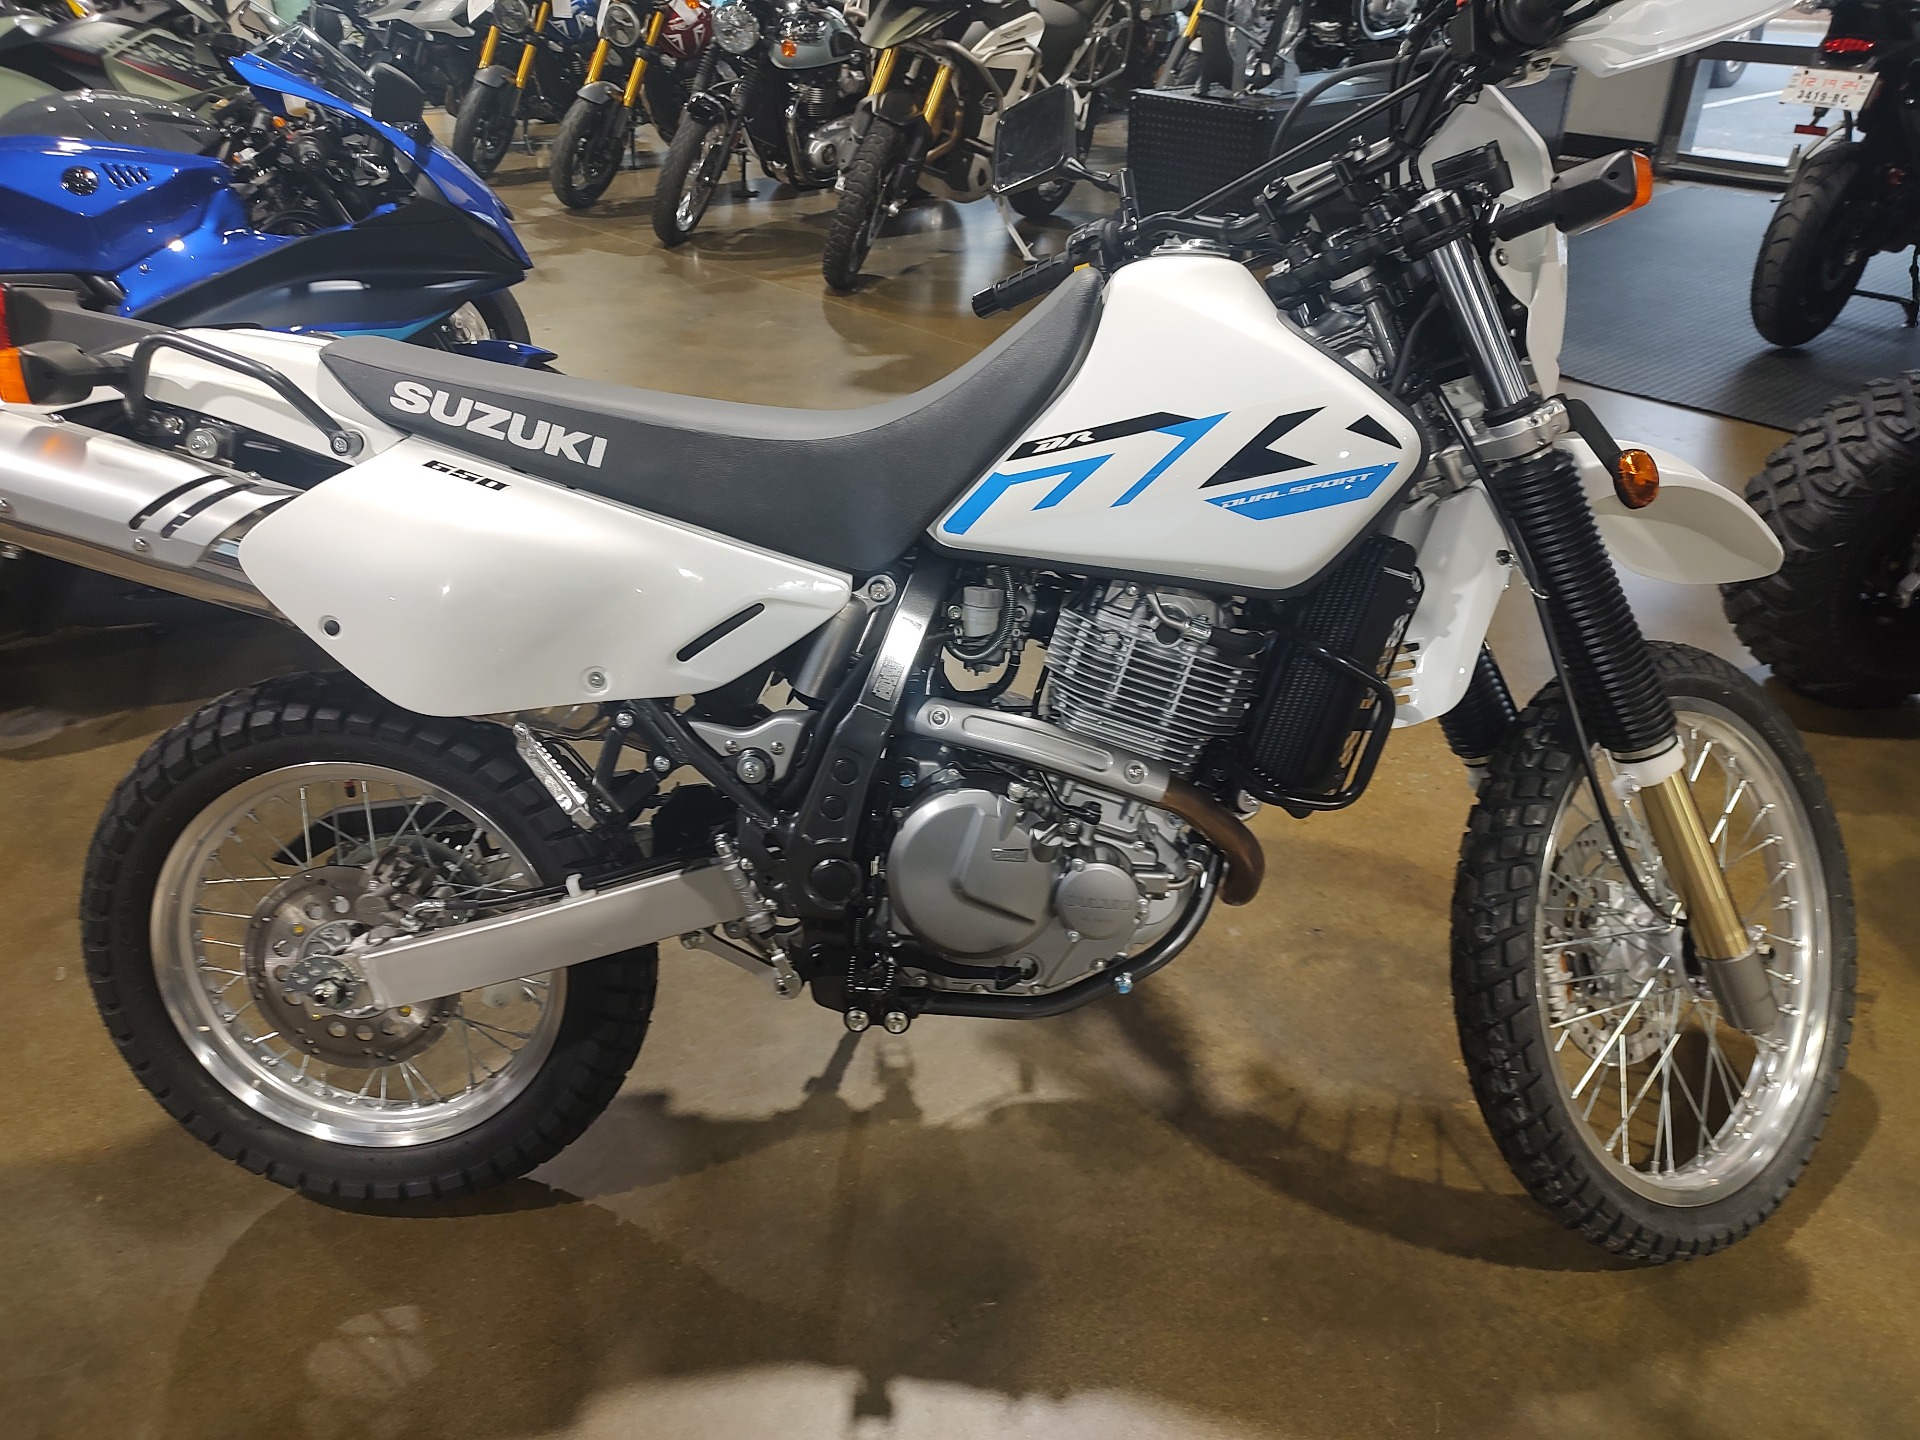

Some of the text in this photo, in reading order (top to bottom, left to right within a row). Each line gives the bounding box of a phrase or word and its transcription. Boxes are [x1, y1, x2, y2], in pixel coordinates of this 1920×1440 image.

[1801, 77, 1817, 86] 12
[390, 381, 608, 468] SUZUKI
[1031, 430, 1096, 454] DR
[422, 459, 512, 491] 650
[1221, 472, 1376, 509] DUAL SPORT
